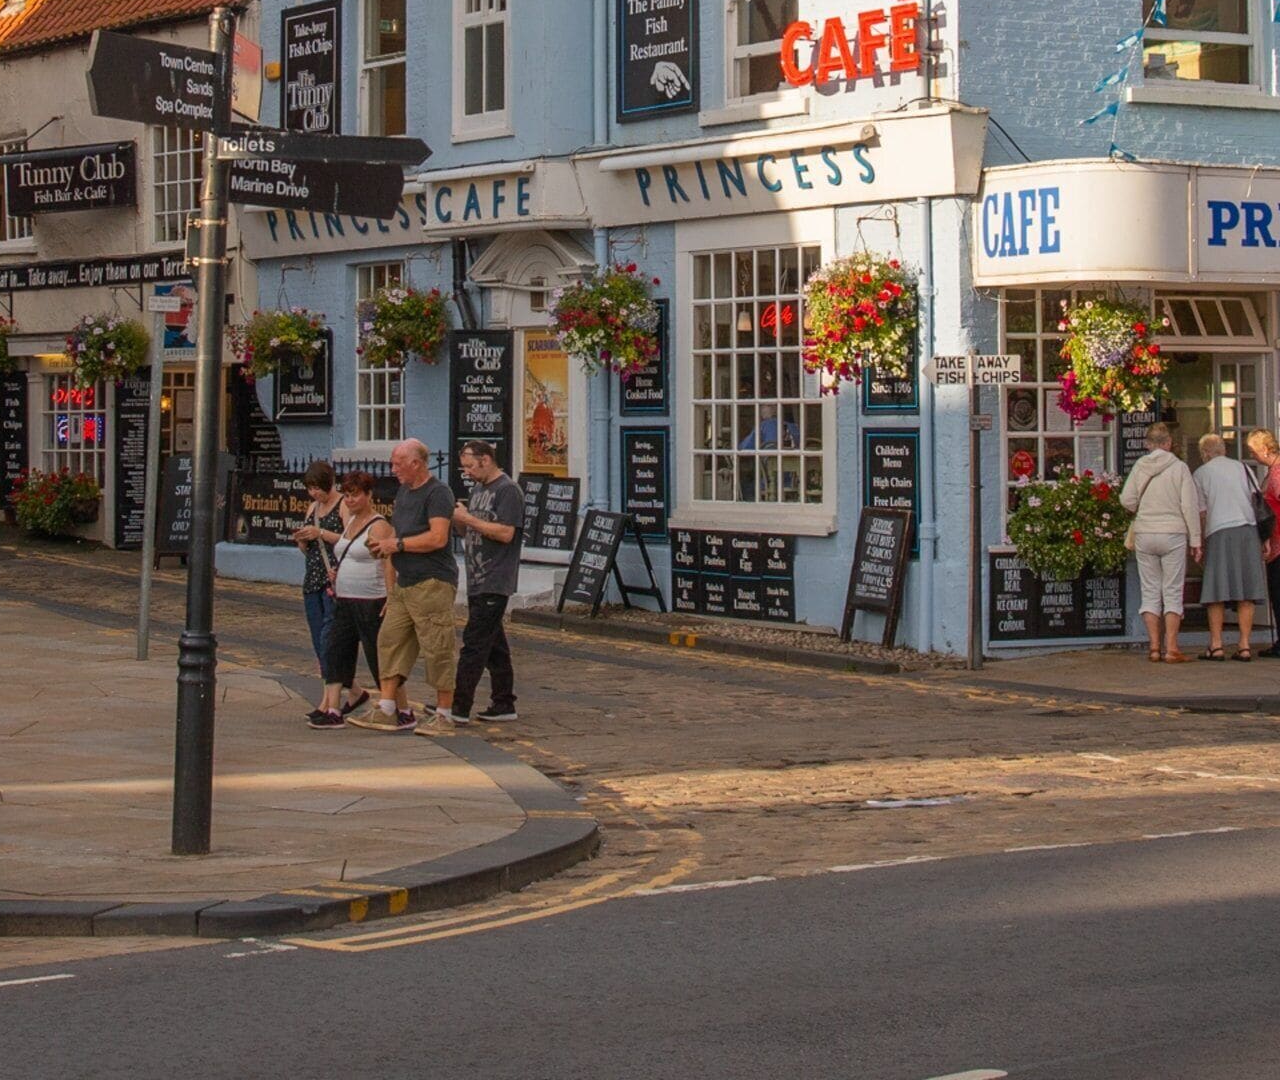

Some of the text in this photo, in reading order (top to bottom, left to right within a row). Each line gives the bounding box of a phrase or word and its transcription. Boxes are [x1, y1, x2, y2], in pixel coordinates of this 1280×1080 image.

[645, 16, 667, 36] Fish
[289, 39, 333, 58] Fish Chips
[630, 37, 688, 61] Restaurant.
[160, 52, 214, 74] Town Centre
[297, 70, 315, 87] The
[187, 79, 213, 96] Sands
[288, 82, 334, 110] Tunny
[156, 96, 213, 119] Spa Complex
[303, 108, 329, 130] Club
[220, 137, 276, 152] Toilets
[13, 153, 125, 191] Tunny Club
[233, 158, 296, 178] North Bay
[635, 142, 875, 207] PRINCESS
[231, 176, 309, 198] Marine Drive
[34, 184, 107, 204] Fish Bar & Café
[435, 177, 530, 223] CAFE
[982, 187, 1060, 258] CAFE
[28, 268, 46, 286] Take
[79, 264, 104, 286] Enjoy
[106, 262, 128, 281] them
[130, 265, 141, 279] on
[143, 263, 158, 278] our
[469, 338, 486, 349] The
[458, 342, 505, 359] Tunny
[474, 356, 501, 370] Club
[934, 356, 1010, 369] TAKE AWAY
[466, 374, 494, 384] Café &
[936, 370, 1020, 384] FISH CHIPS
[460, 384, 502, 396] Take Away
[871, 380, 912, 395] Since 1906
[281, 392, 324, 405] Fish and Chips
[625, 389, 663, 400] Cooked Food
[471, 403, 493, 414] SMALL
[472, 423, 494, 432] £5.50
[875, 445, 909, 457] Children's
[632, 454, 658, 464] Breakfasts
[882, 457, 902, 468] Menu
[635, 469, 654, 479] Snacks
[635, 484, 656, 494] Lunches
[873, 476, 912, 489] High Chairs
[874, 496, 912, 508] Free Lollies
[251, 516, 284, 531] Sir Terry
[678, 531, 691, 543] Fish
[706, 535, 723, 546] Cakes
[732, 538, 758, 549] Gammon
[768, 537, 785, 548] Grills
[675, 552, 694, 565] Chips
[767, 559, 787, 570] Steaks
[740, 559, 752, 572] Egg
[734, 599, 760, 611] Lunches
